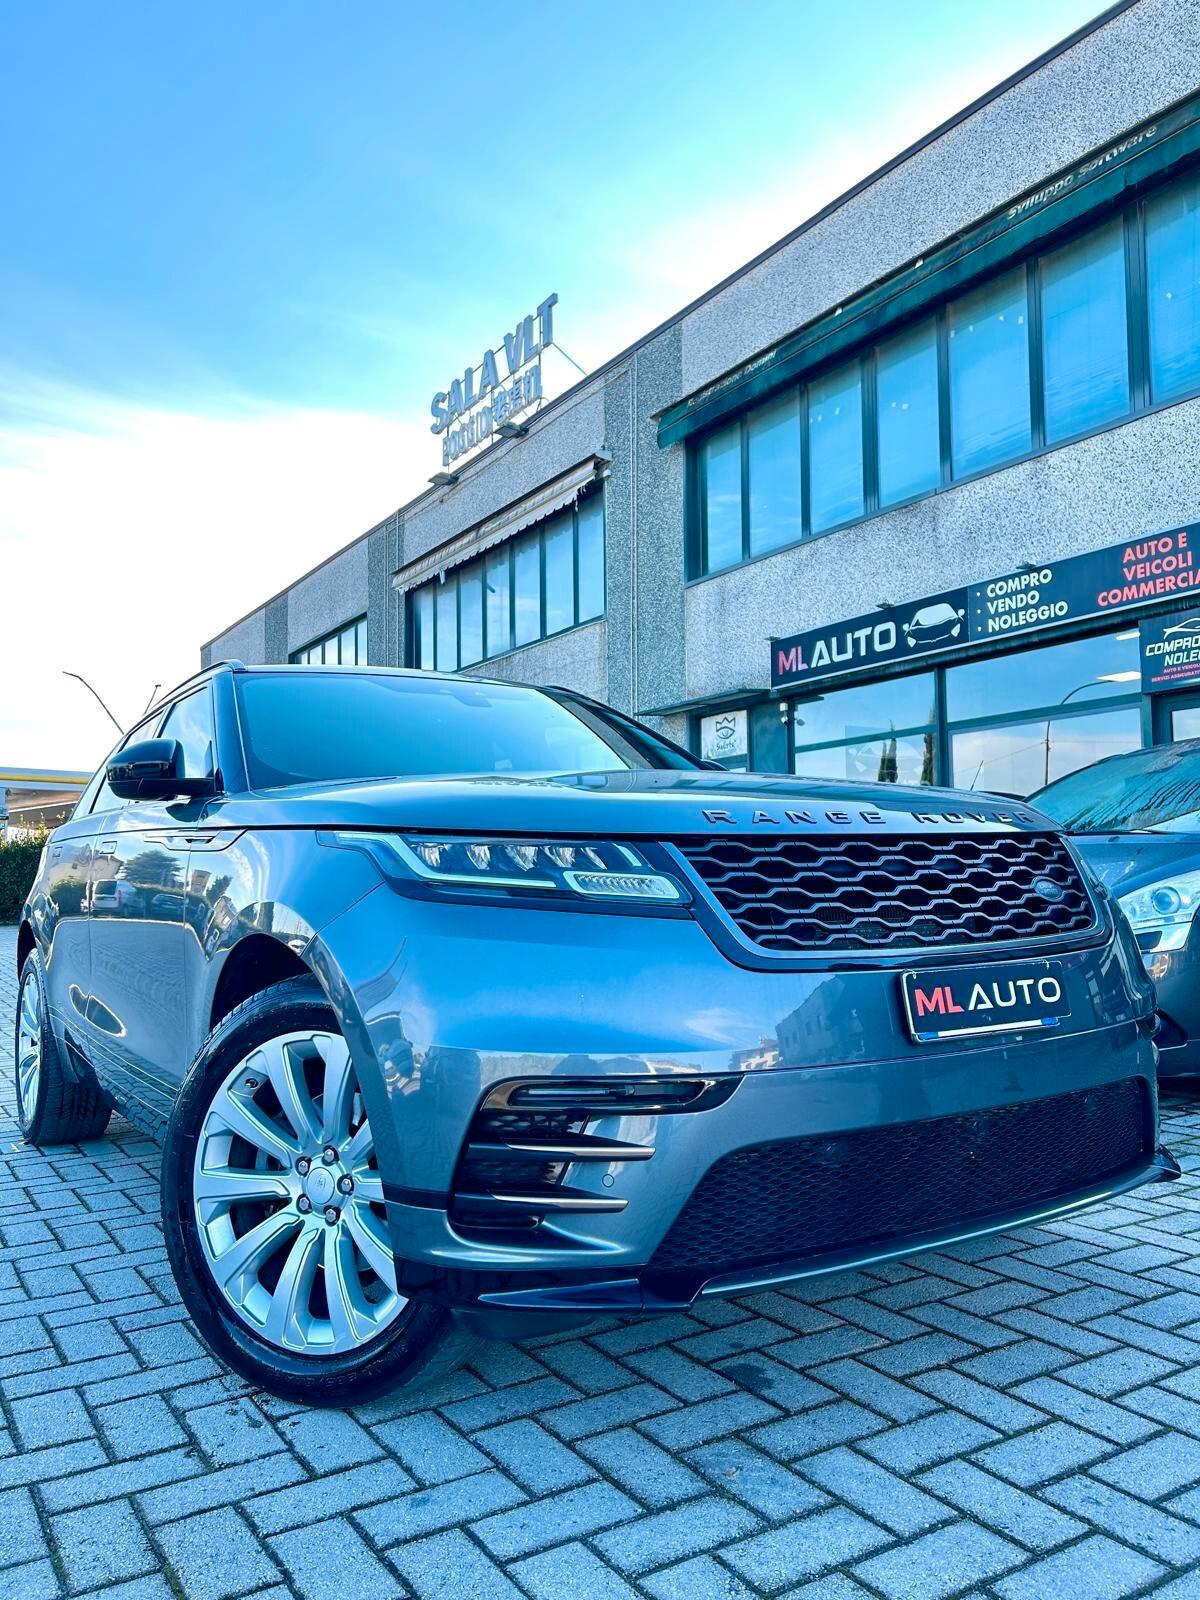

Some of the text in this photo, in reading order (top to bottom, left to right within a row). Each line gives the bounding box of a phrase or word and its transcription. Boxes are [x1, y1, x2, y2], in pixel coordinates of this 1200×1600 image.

[430, 349, 500, 435] SALA
[503, 292, 558, 375] VLT
[1122, 532, 1188, 563] AUTO E
[1123, 551, 1193, 581] VEICOLI
[986, 569, 1052, 599] COMPRO
[986, 590, 1040, 616] VENDO
[987, 601, 1068, 634] NOLEGGIO
[1163, 666, 1177, 674] AUTO
[1164, 648, 1200, 667] NOLE
[701, 809, 1036, 825] RANGE ROVER
